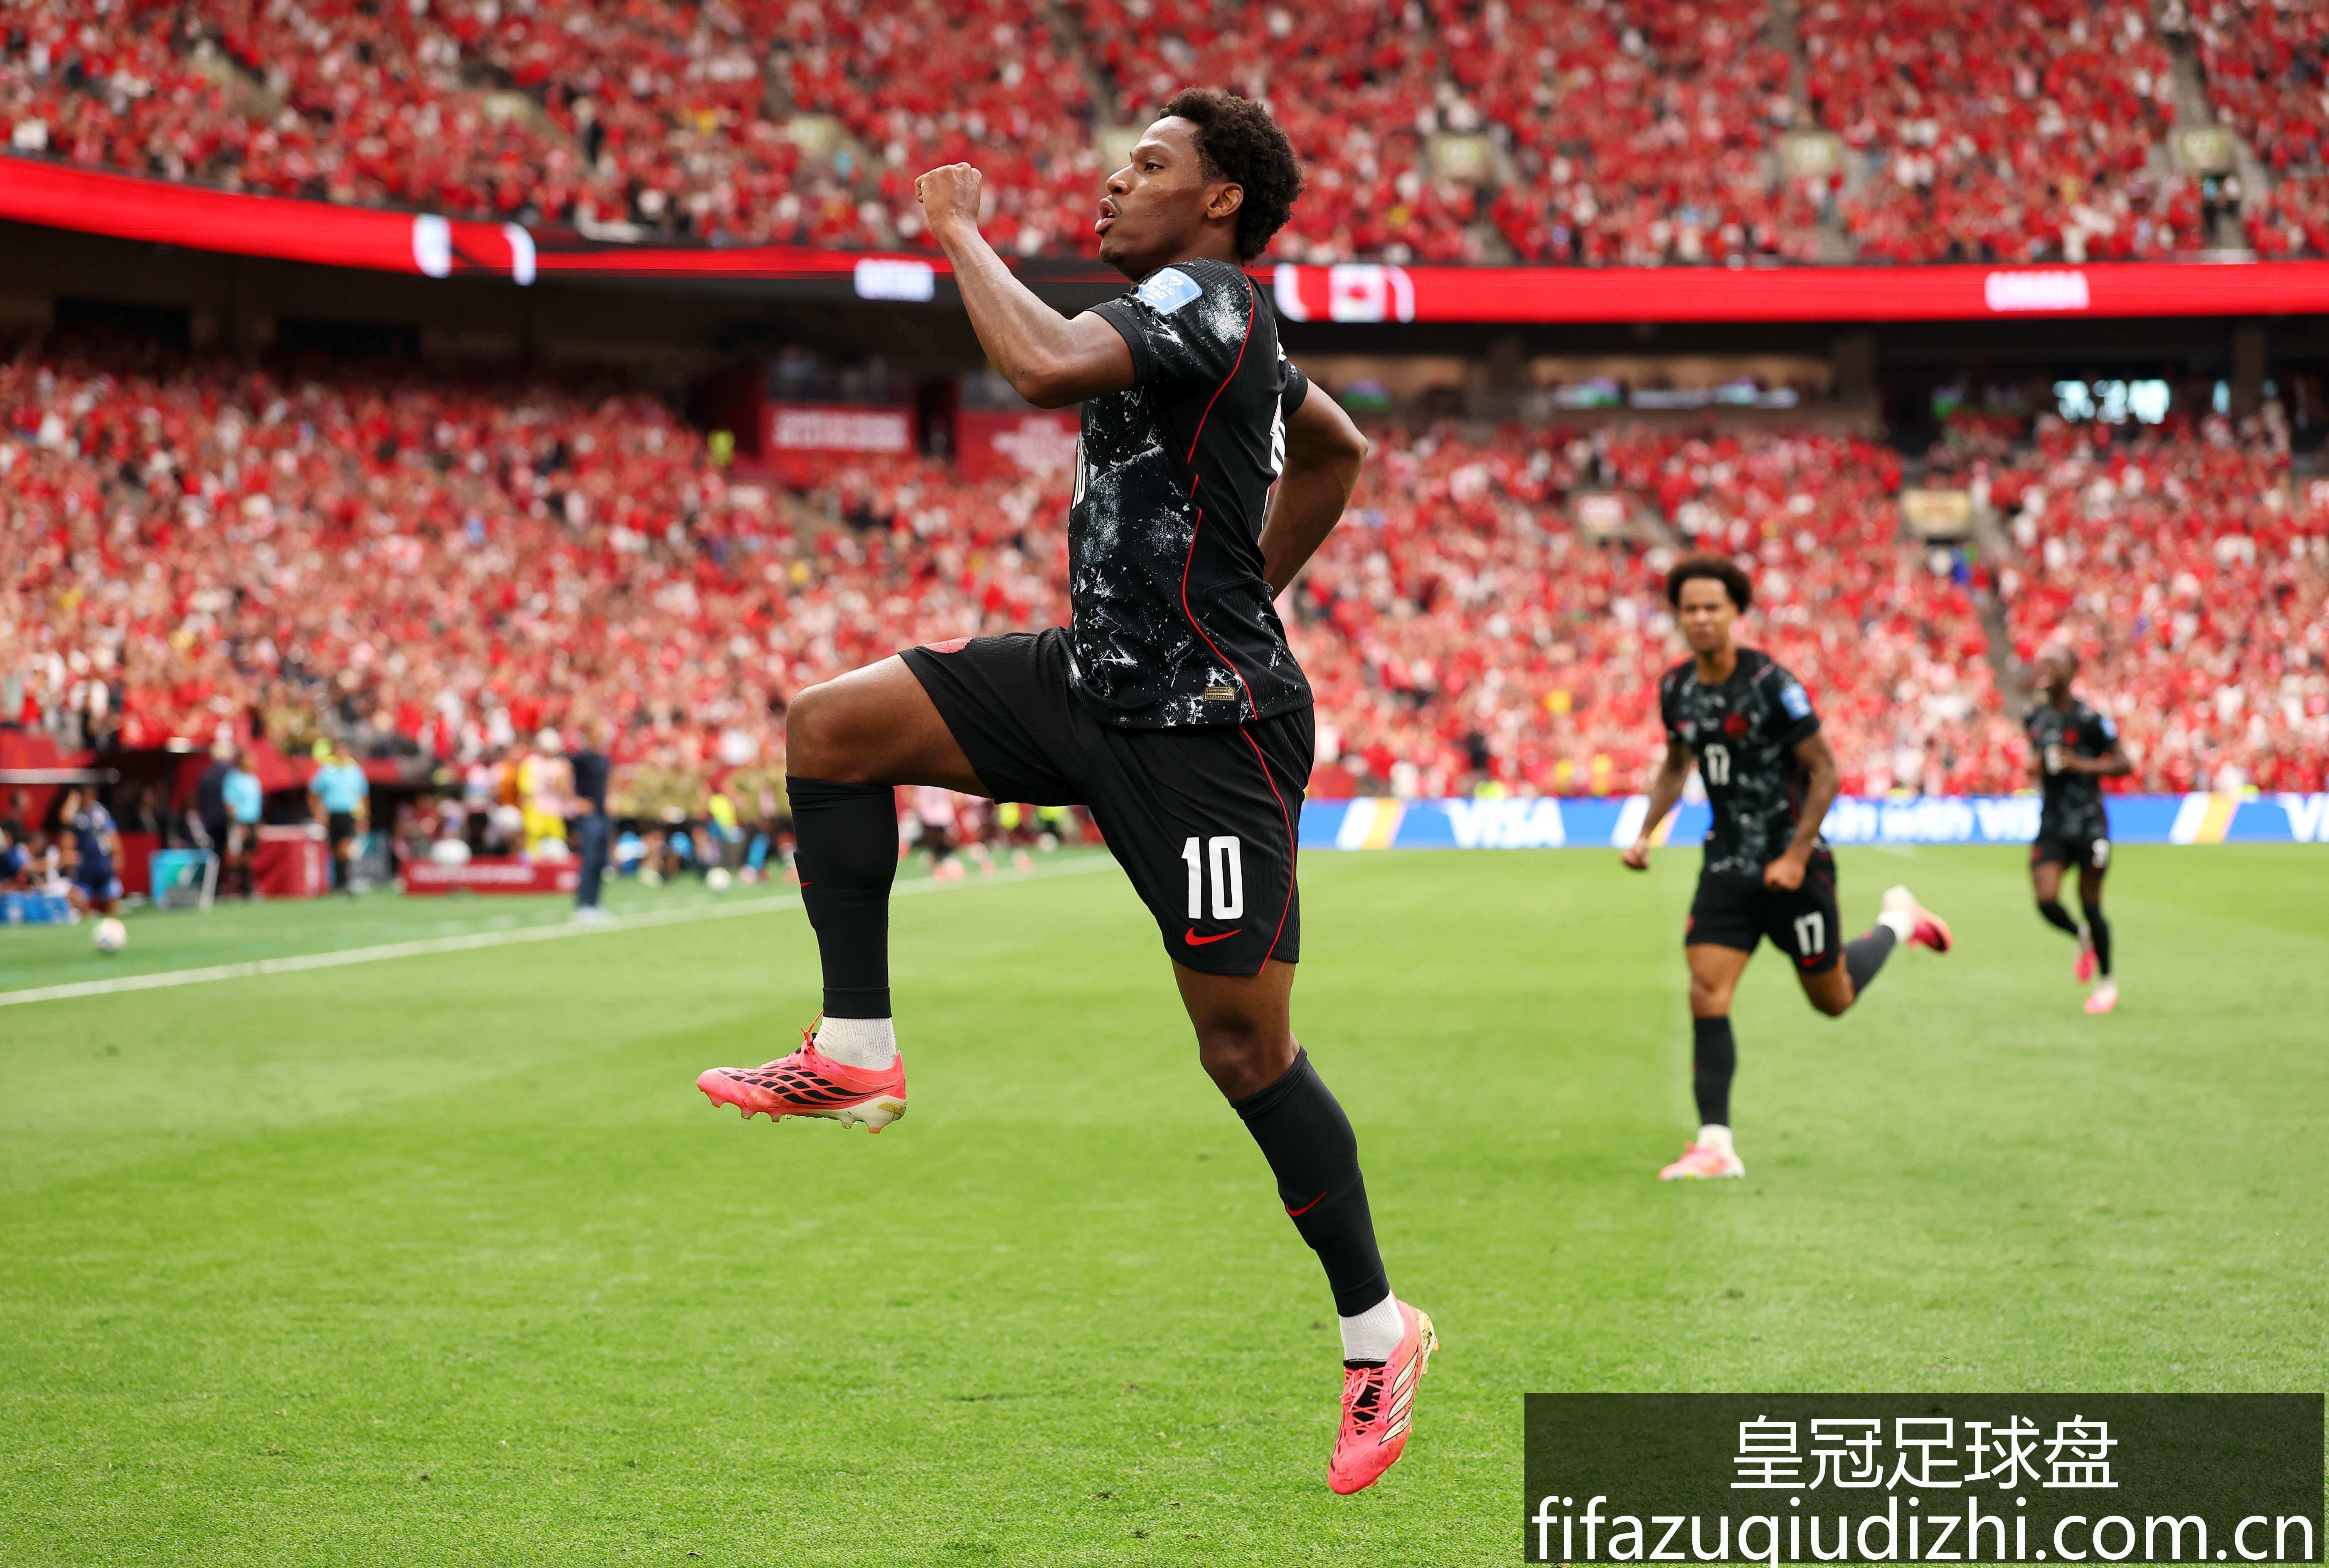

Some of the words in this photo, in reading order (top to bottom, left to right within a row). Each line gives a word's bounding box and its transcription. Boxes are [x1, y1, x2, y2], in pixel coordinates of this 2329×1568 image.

[1704, 742, 1730, 786] 17
[1440, 797, 1568, 849] VISA
[1974, 797, 2042, 841] VIS
[1182, 836, 1243, 920] 10
[1793, 911, 1825, 955] 17
